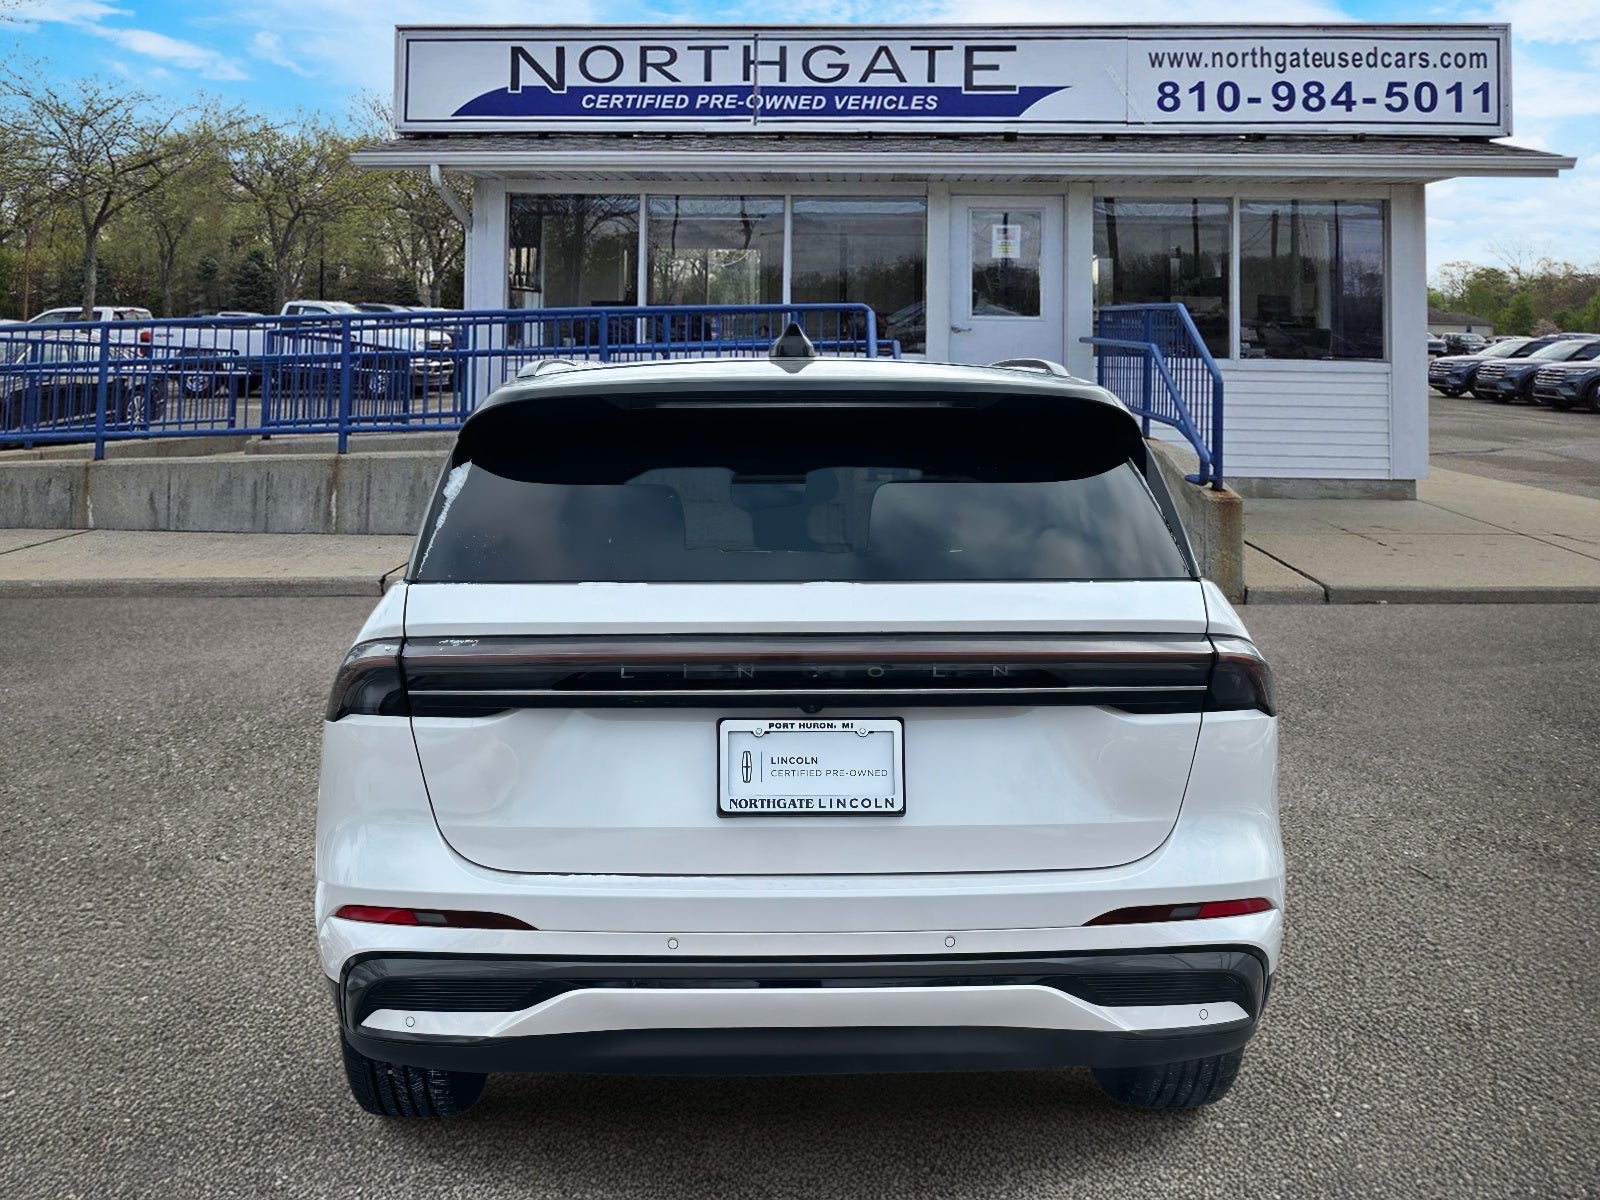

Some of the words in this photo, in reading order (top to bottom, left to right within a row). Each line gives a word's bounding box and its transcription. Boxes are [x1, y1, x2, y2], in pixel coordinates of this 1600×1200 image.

[1148, 46, 1489, 73] www.northgateusedcars.com
[509, 44, 1018, 93] NORTHGATE
[581, 94, 689, 110] CERTIFIED
[695, 94, 827, 111] PRE-OWNED
[834, 95, 939, 111] VEHICLES
[1156, 80, 1491, 114] 810-984-5011
[770, 756, 818, 765] LINCOLN
[770, 769, 822, 777] CERTIFIED
[825, 769, 888, 777] PRE-OWNED
[729, 798, 815, 809] NORTHGATE
[818, 798, 895, 809] LINCOLN
